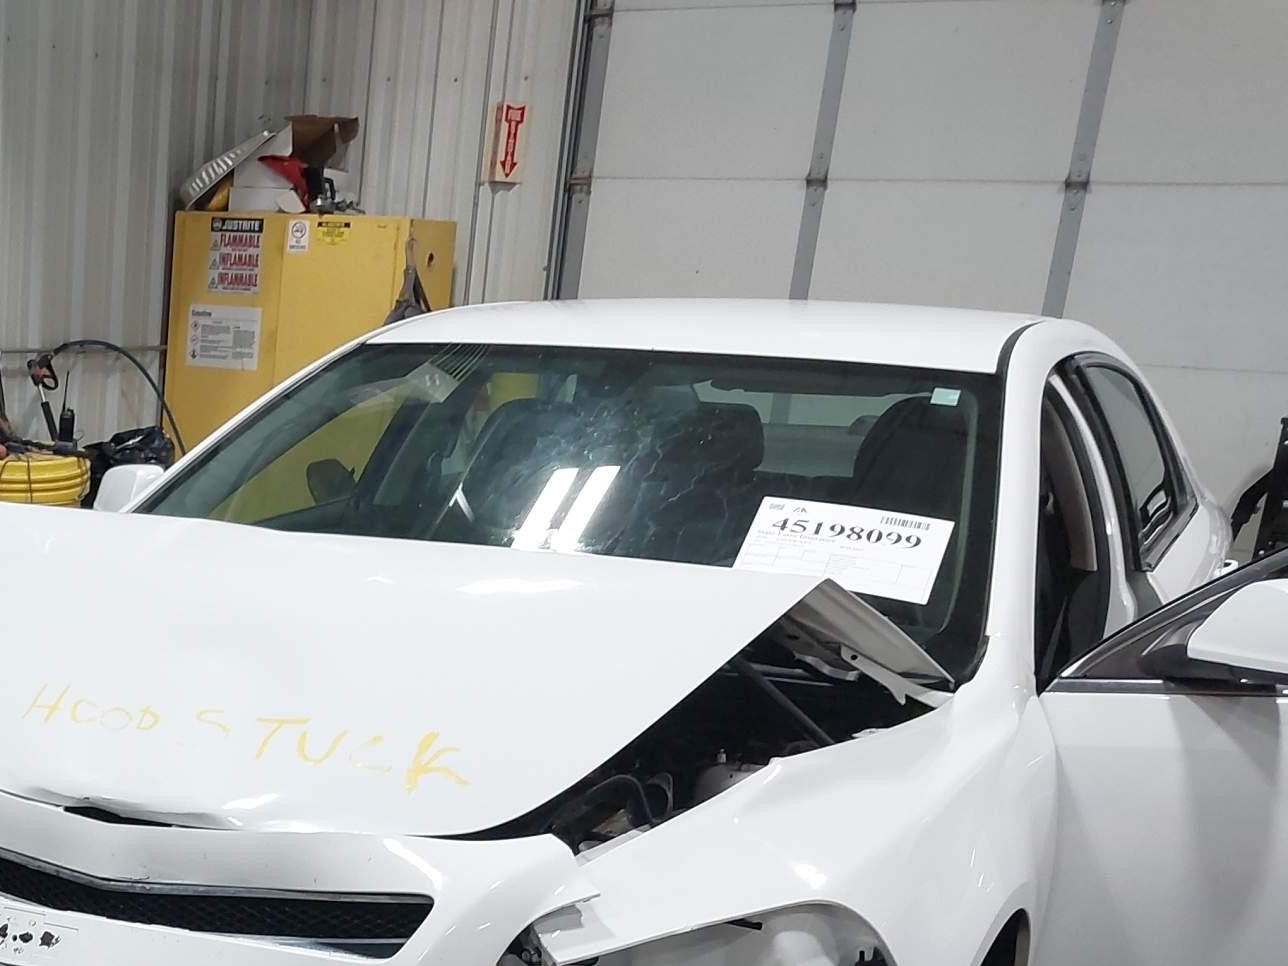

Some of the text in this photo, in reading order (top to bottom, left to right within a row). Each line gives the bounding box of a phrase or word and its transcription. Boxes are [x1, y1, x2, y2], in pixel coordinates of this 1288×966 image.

[222, 219, 261, 232] JUSTRITE
[220, 232, 261, 249] FLAMMABLE
[771, 518, 922, 549] 45198099
